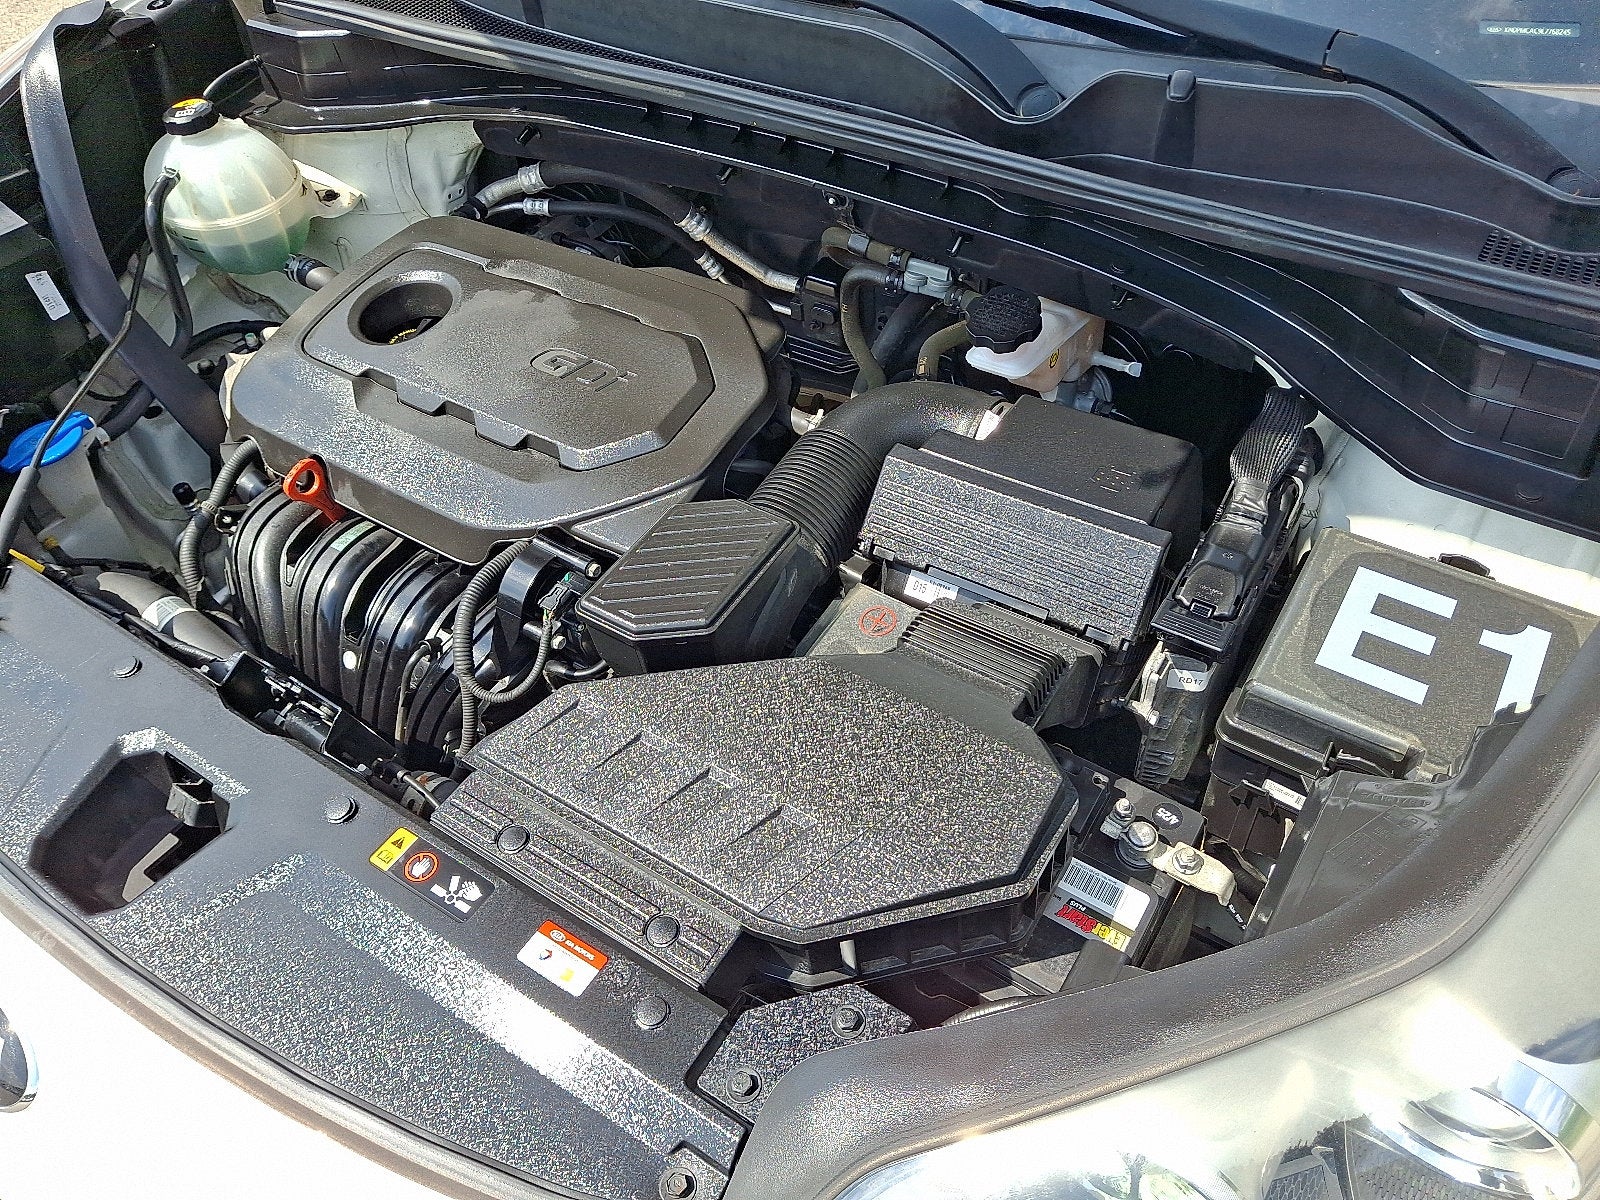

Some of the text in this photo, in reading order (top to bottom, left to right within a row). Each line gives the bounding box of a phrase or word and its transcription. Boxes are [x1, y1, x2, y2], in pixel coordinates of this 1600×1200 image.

[1314, 565, 1553, 714] E1
[1179, 676, 1204, 686] RD17
[1155, 807, 1180, 825] 4/25
[1069, 900, 1087, 912] PLUS
